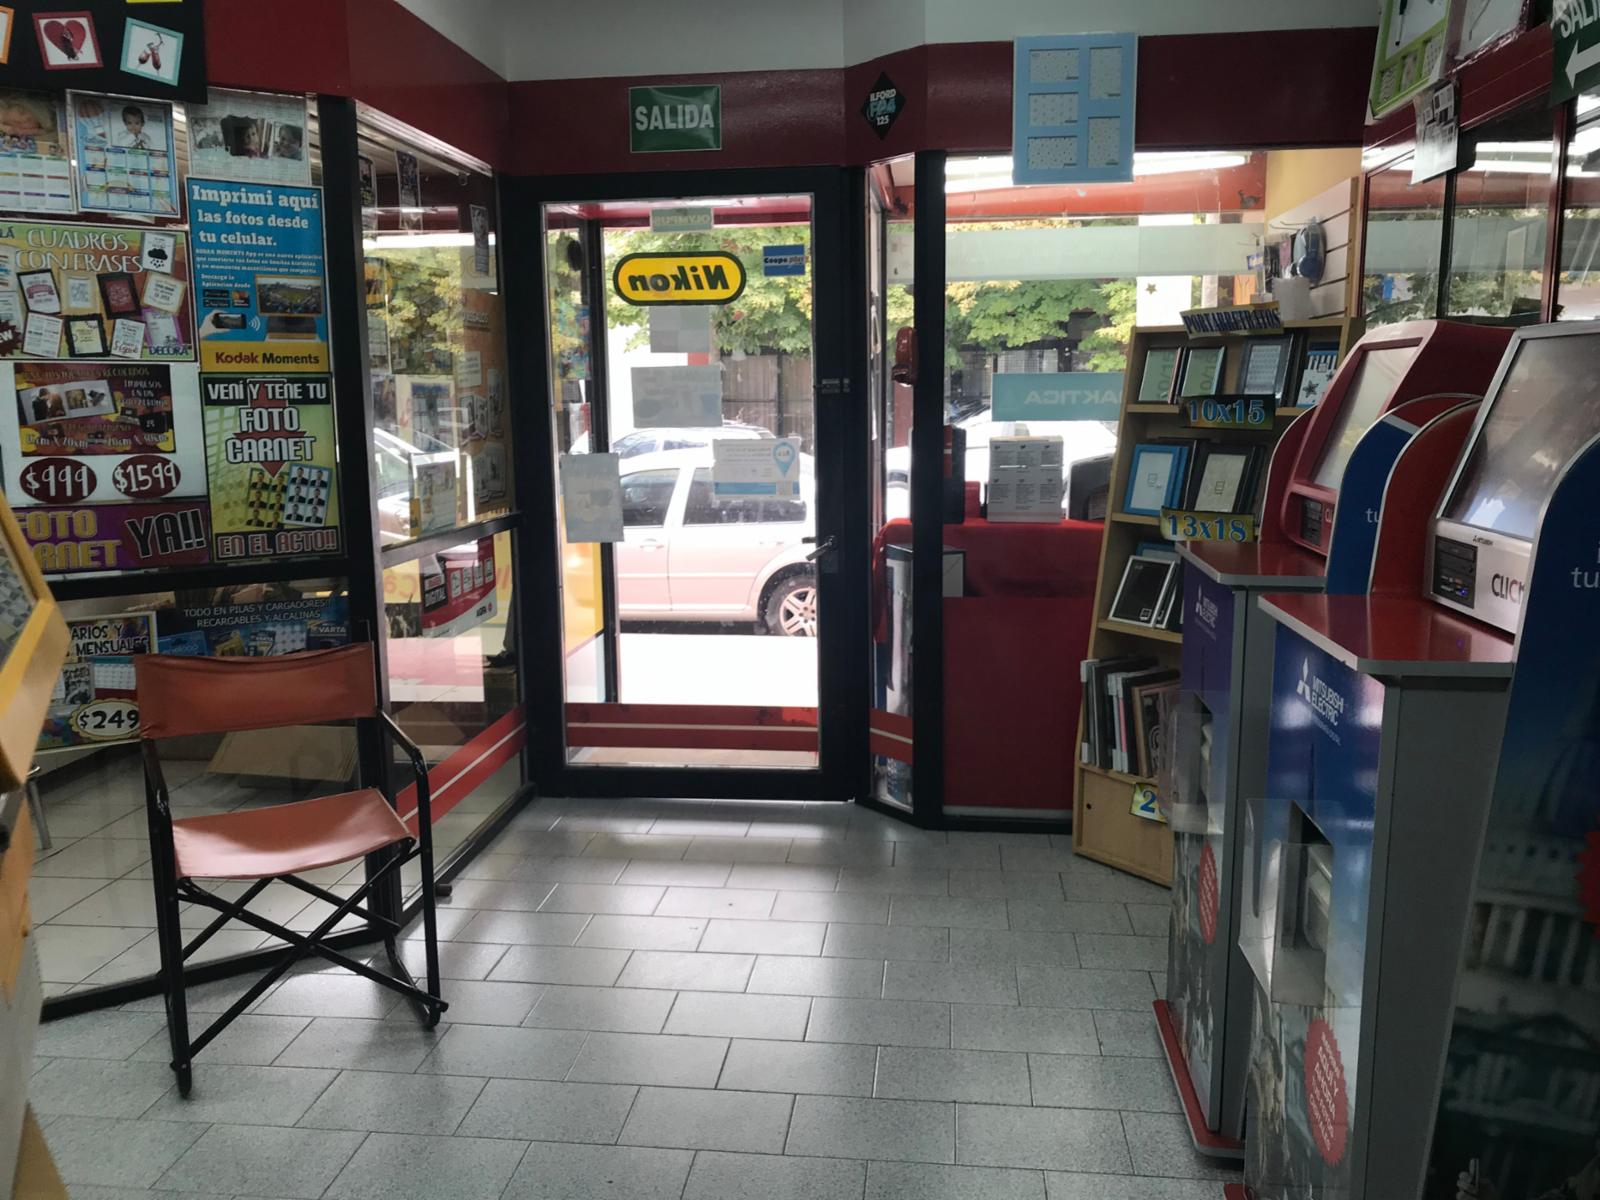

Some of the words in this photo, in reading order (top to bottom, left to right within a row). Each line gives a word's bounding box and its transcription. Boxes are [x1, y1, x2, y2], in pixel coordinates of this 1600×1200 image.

[869, 88, 897, 102] ILFORD
[634, 103, 715, 131] SALIDA
[876, 115, 889, 126] 125
[197, 209, 222, 223] las
[225, 211, 264, 226] fotos
[267, 214, 309, 229] desde
[28, 228, 129, 251] CUADROS
[199, 230, 217, 243] tu
[220, 231, 277, 246] celular.
[15, 250, 68, 271] CON
[72, 252, 144, 273] FRASES
[215, 352, 260, 364] Kodak
[262, 353, 320, 364] Moments
[248, 383, 260, 400] Y
[306, 383, 327, 399] TU
[239, 407, 300, 432] FOTO
[1189, 399, 1266, 425] 10x15
[226, 436, 316, 464] CARNET
[25, 465, 89, 497] $999
[114, 462, 177, 492] $1599
[1168, 513, 1247, 543] 13x18
[217, 534, 245, 558] EN
[248, 533, 273, 555] EL
[183, 608, 212, 618] TODO
[213, 606, 227, 616] EN
[229, 604, 255, 615] PILAS
[257, 604, 264, 612] Y
[197, 614, 262, 628] RECARGABLES
[114, 624, 122, 637] Y
[318, 626, 347, 634] VARTA
[76, 637, 150, 656] MENSUALES
[1311, 691, 1339, 726] ELECTRIC
